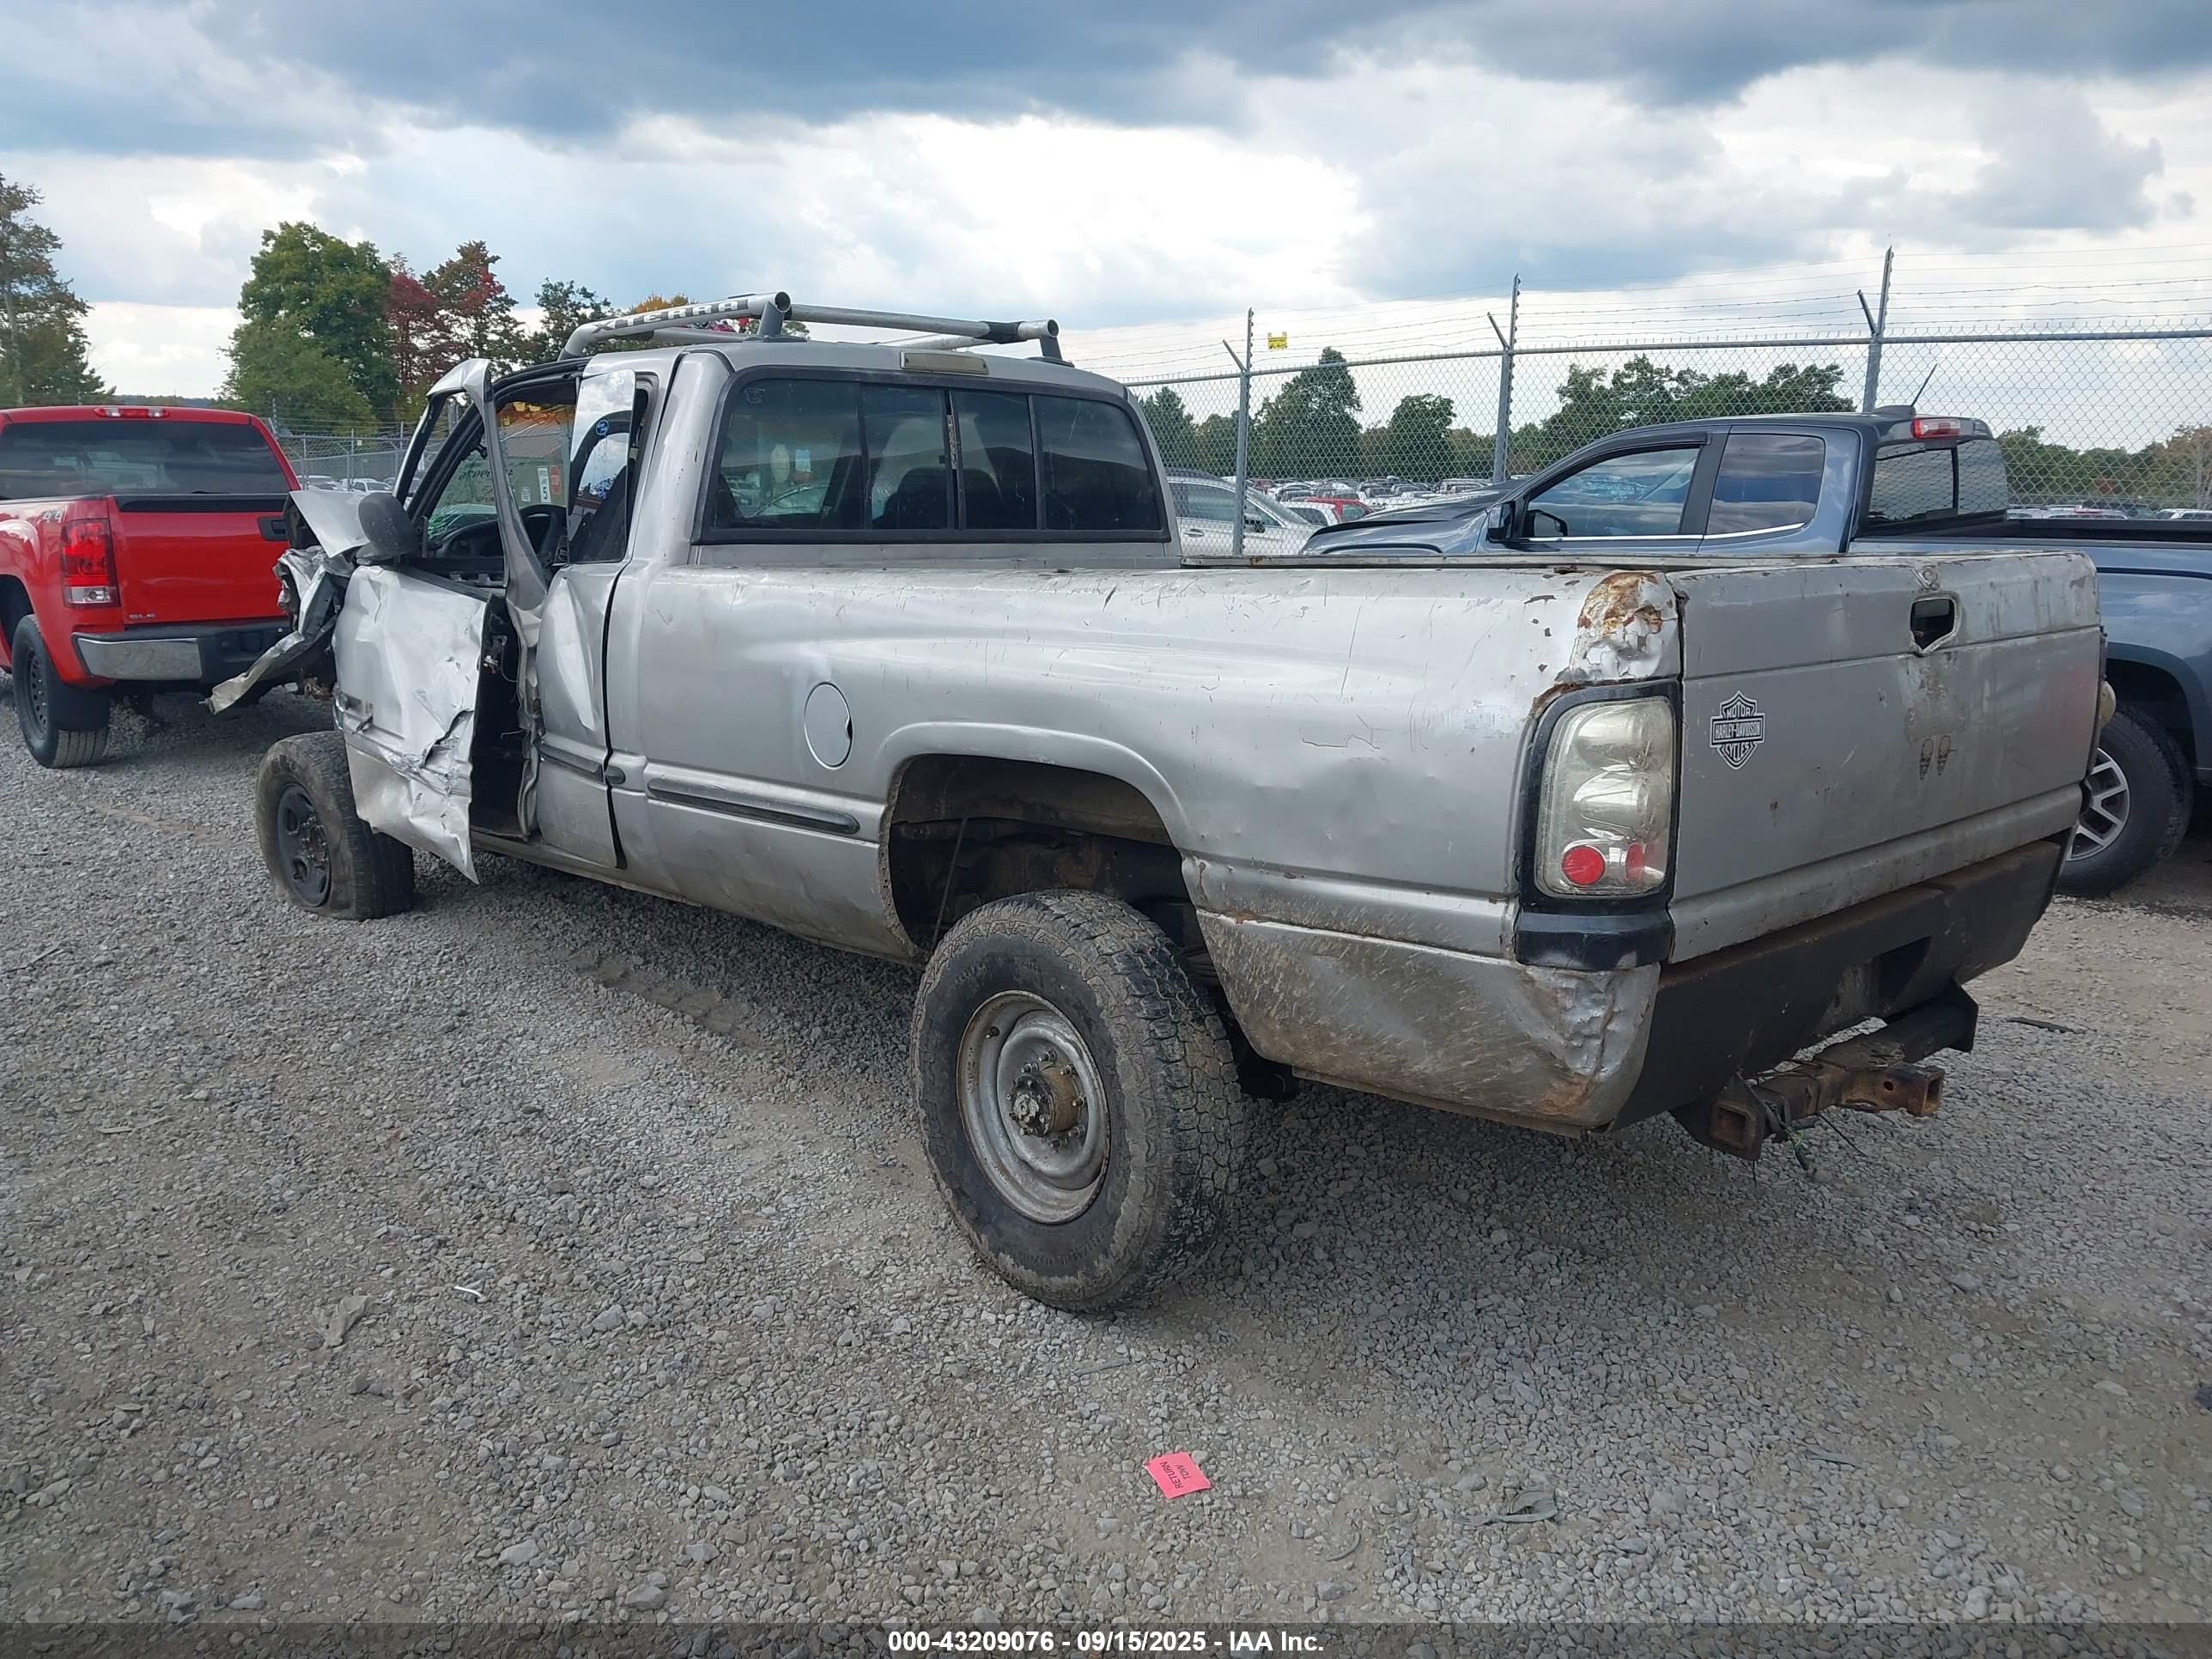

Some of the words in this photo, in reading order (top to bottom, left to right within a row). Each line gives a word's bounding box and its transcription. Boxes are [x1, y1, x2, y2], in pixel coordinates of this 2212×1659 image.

[592, 301, 744, 334] XTERRA
[1726, 702, 1751, 719] MOTOR
[1716, 722, 1760, 739] HARLEY-DAVIDSON
[1725, 743, 1749, 761] CYCLES
[1160, 1462, 1183, 1488] RETURN
[1175, 1465, 1191, 1480] TOW
